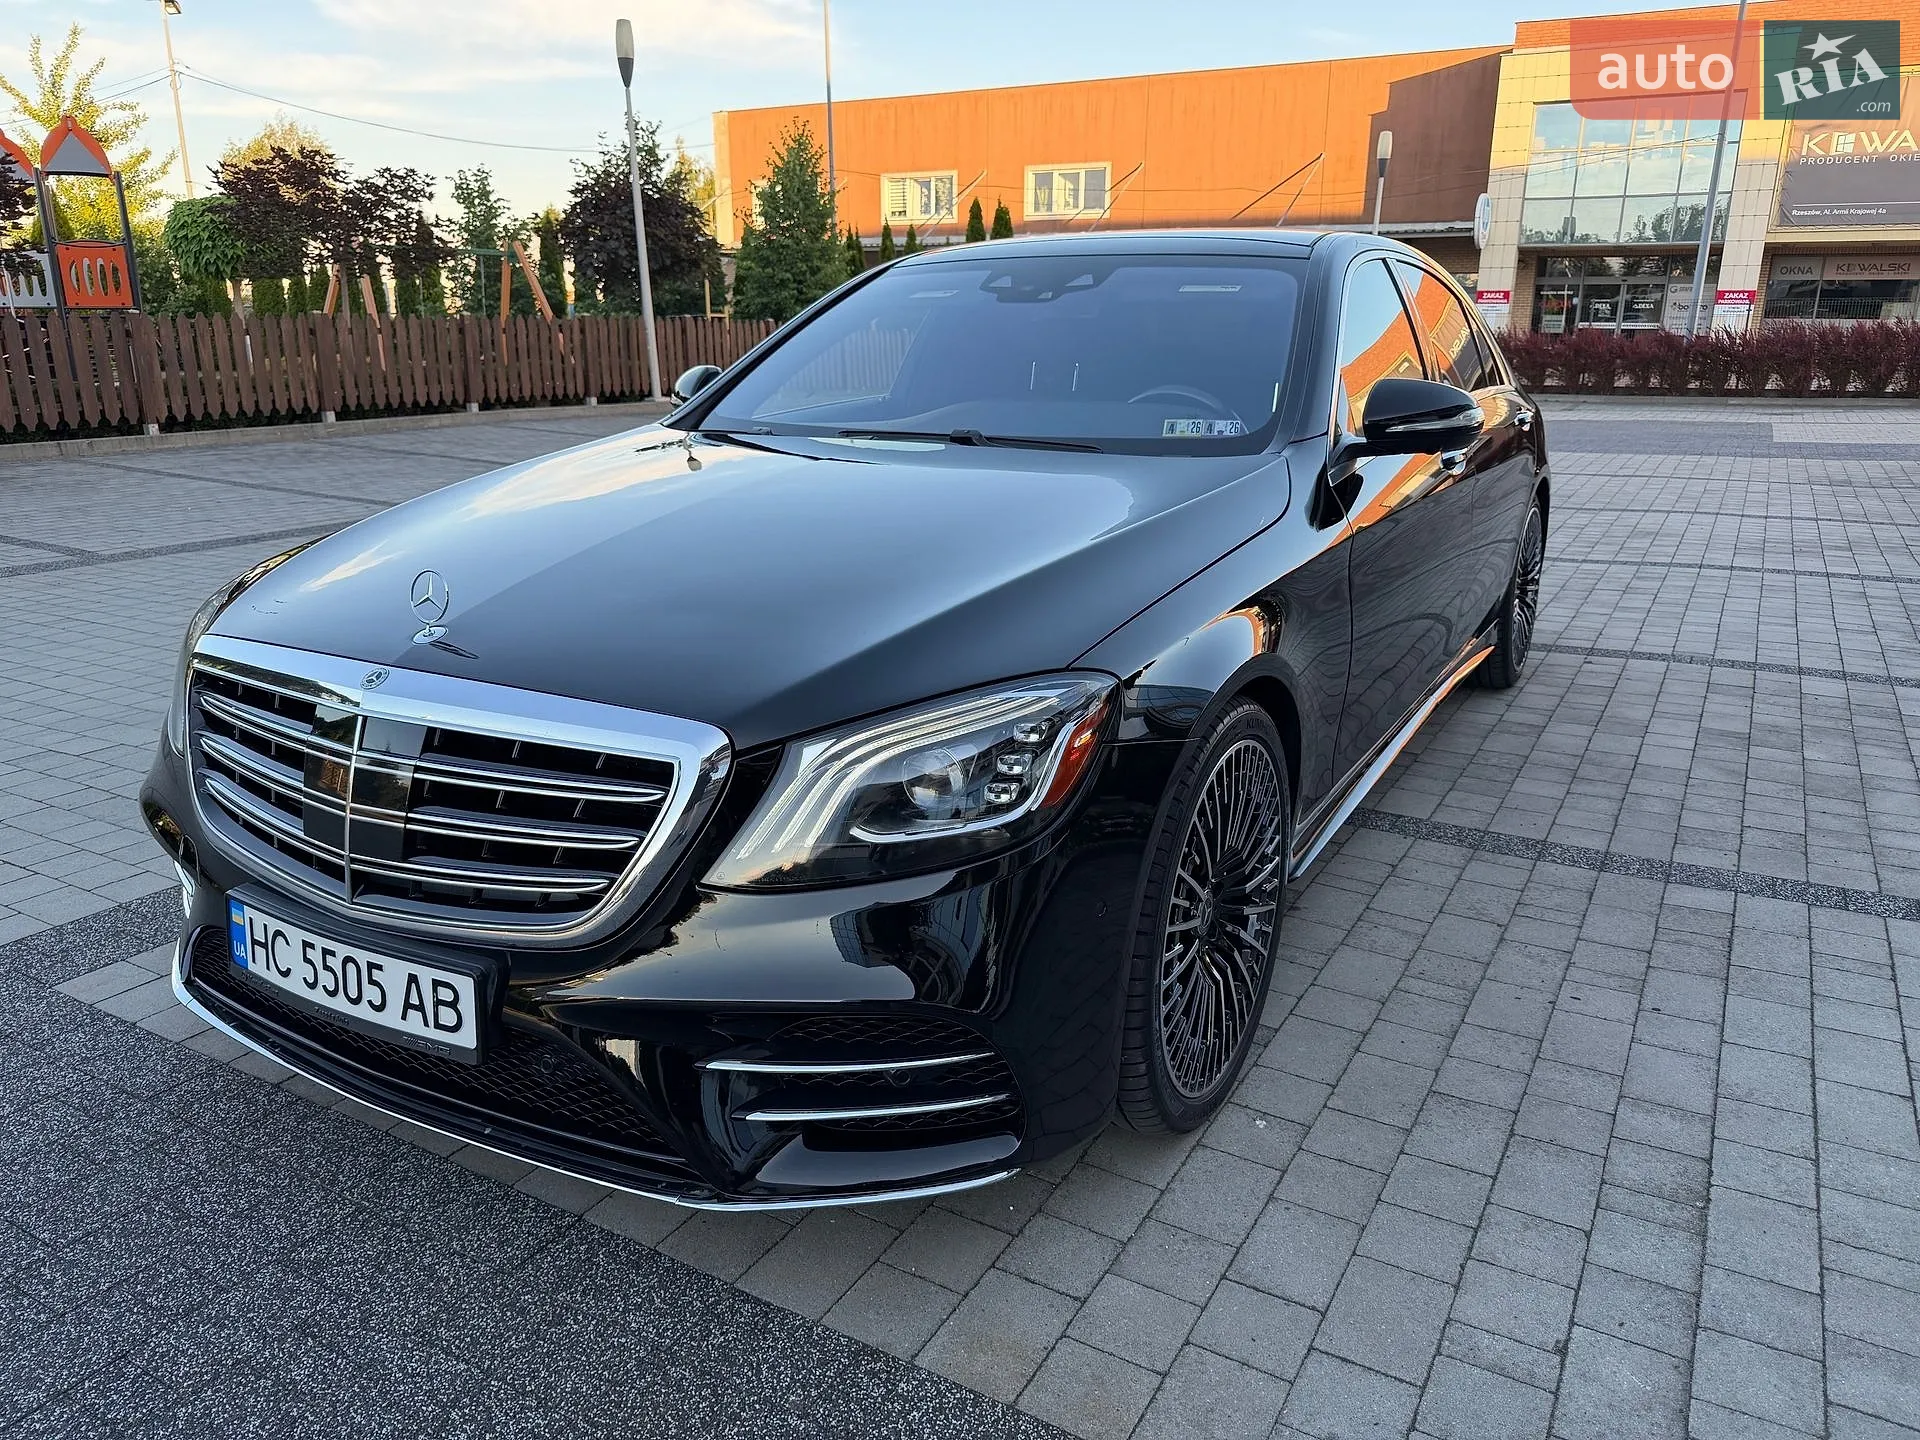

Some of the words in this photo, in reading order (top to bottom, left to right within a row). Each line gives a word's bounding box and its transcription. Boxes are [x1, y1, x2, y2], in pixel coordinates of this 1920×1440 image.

[1800, 155, 1879, 165] PRODUCENT
[1849, 207, 1877, 216] Krajowej
[1779, 266, 1814, 276] OKNA
[1190, 421, 1201, 434] 26
[1229, 421, 1240, 434] 26
[233, 940, 247, 960] UA
[248, 915, 292, 978] HC
[301, 938, 387, 1013] 5505
[400, 972, 463, 1034] AB
